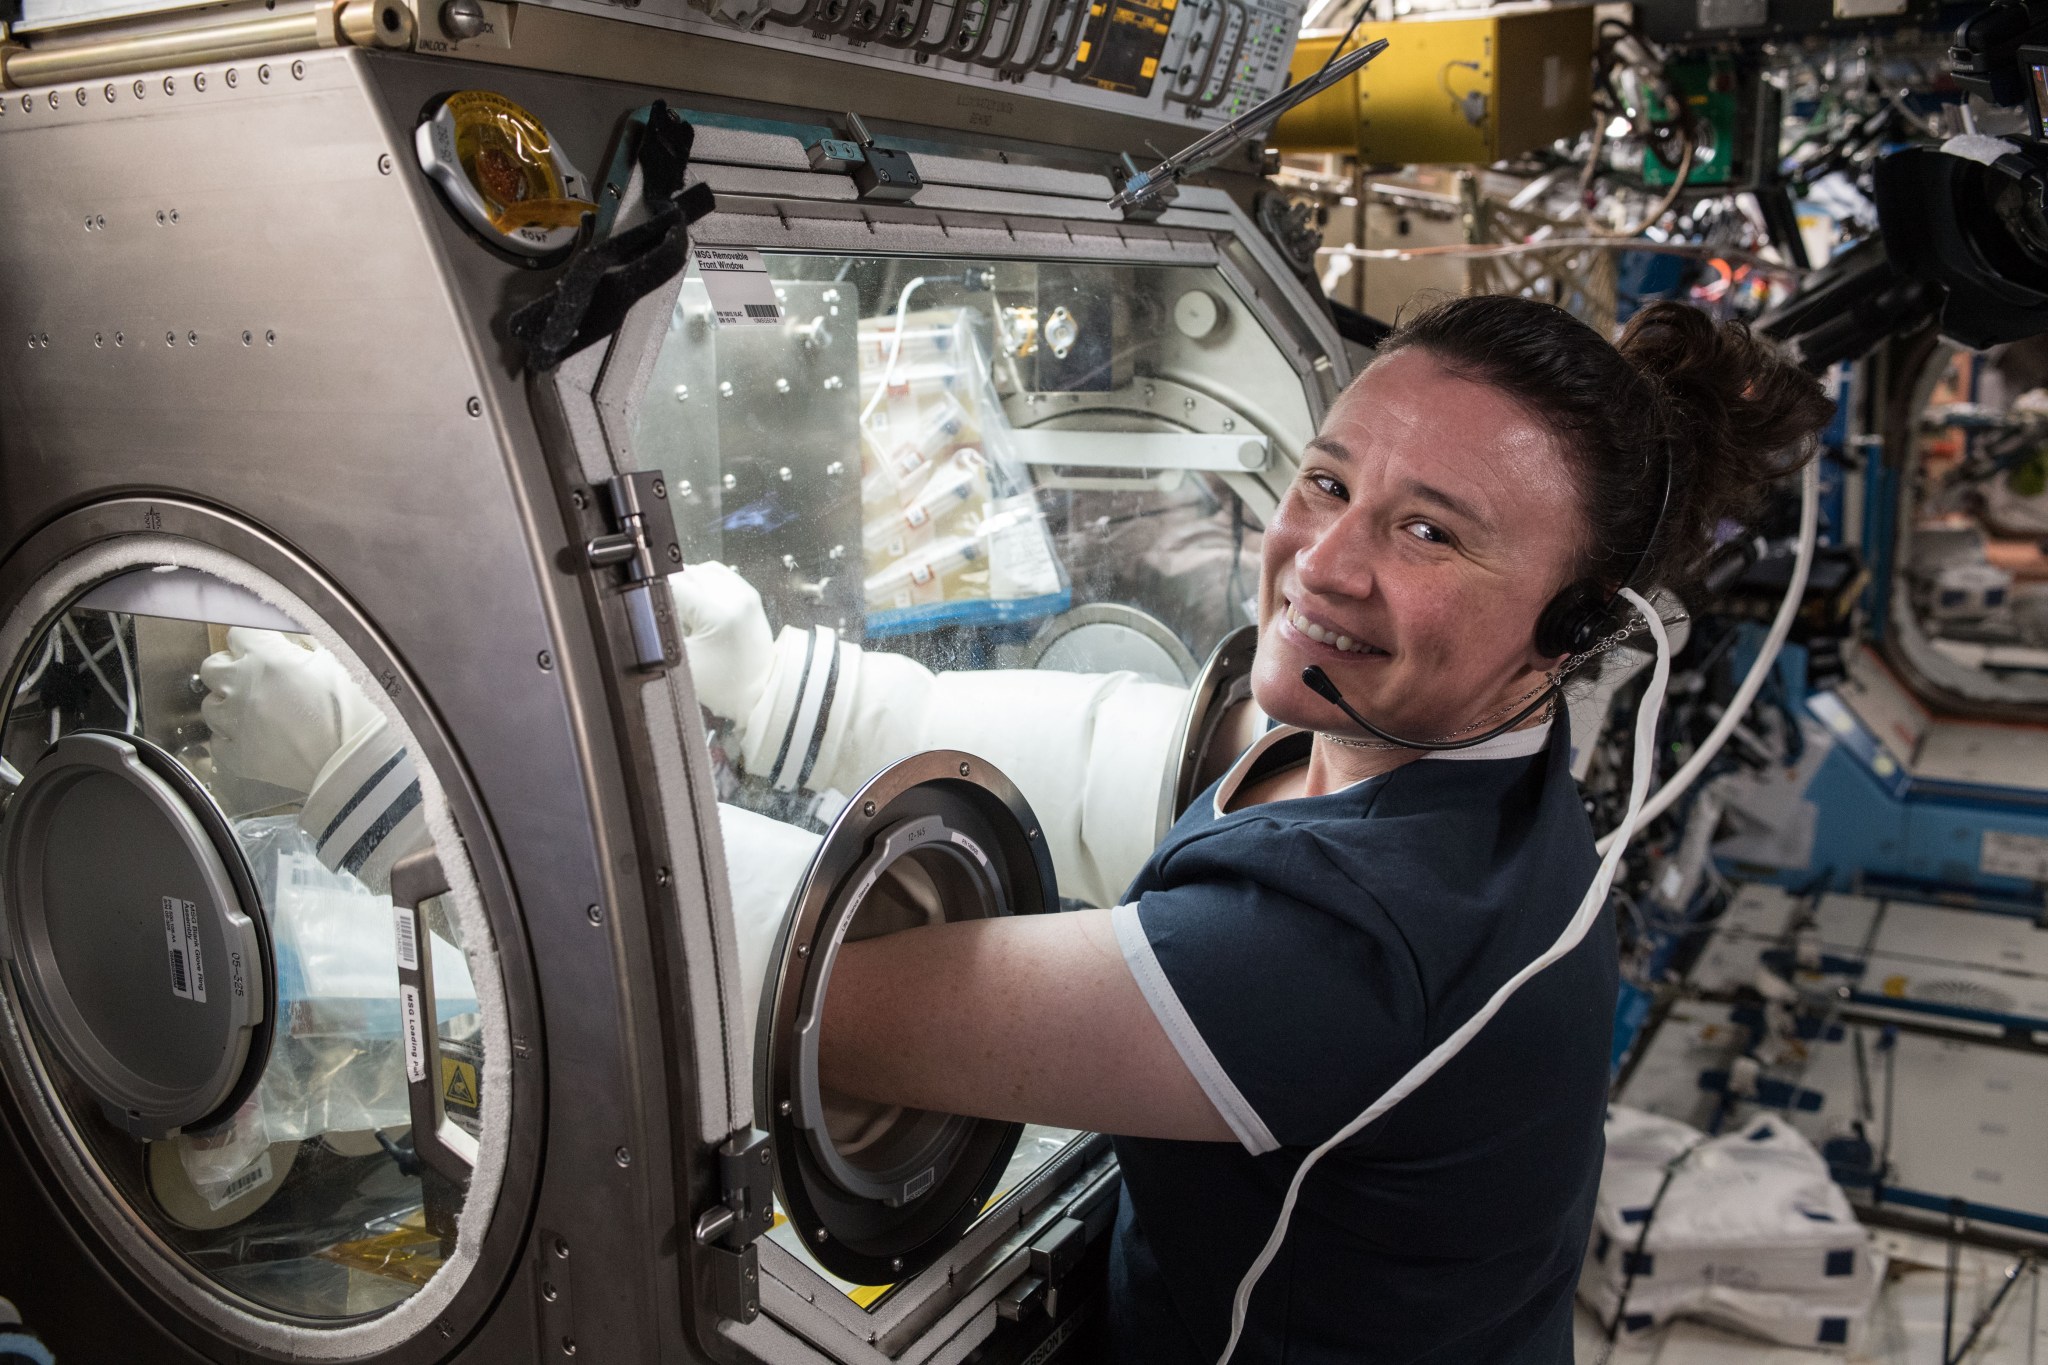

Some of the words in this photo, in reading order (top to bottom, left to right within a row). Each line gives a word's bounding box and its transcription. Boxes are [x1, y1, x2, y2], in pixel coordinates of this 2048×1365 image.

[420, 40, 448, 52] UNLOCK
[952, 62, 974, 70] Canon
[695, 251, 711, 259] MSG
[713, 251, 748, 260] Removable
[698, 261, 717, 269] Front
[718, 261, 744, 270] Window
[847, 900, 859, 920] Science
[858, 883, 870, 899] Sleeve
[184, 902, 192, 940] Assembly
[407, 993, 415, 1017] MSG
[409, 1019, 418, 1058] Loading
